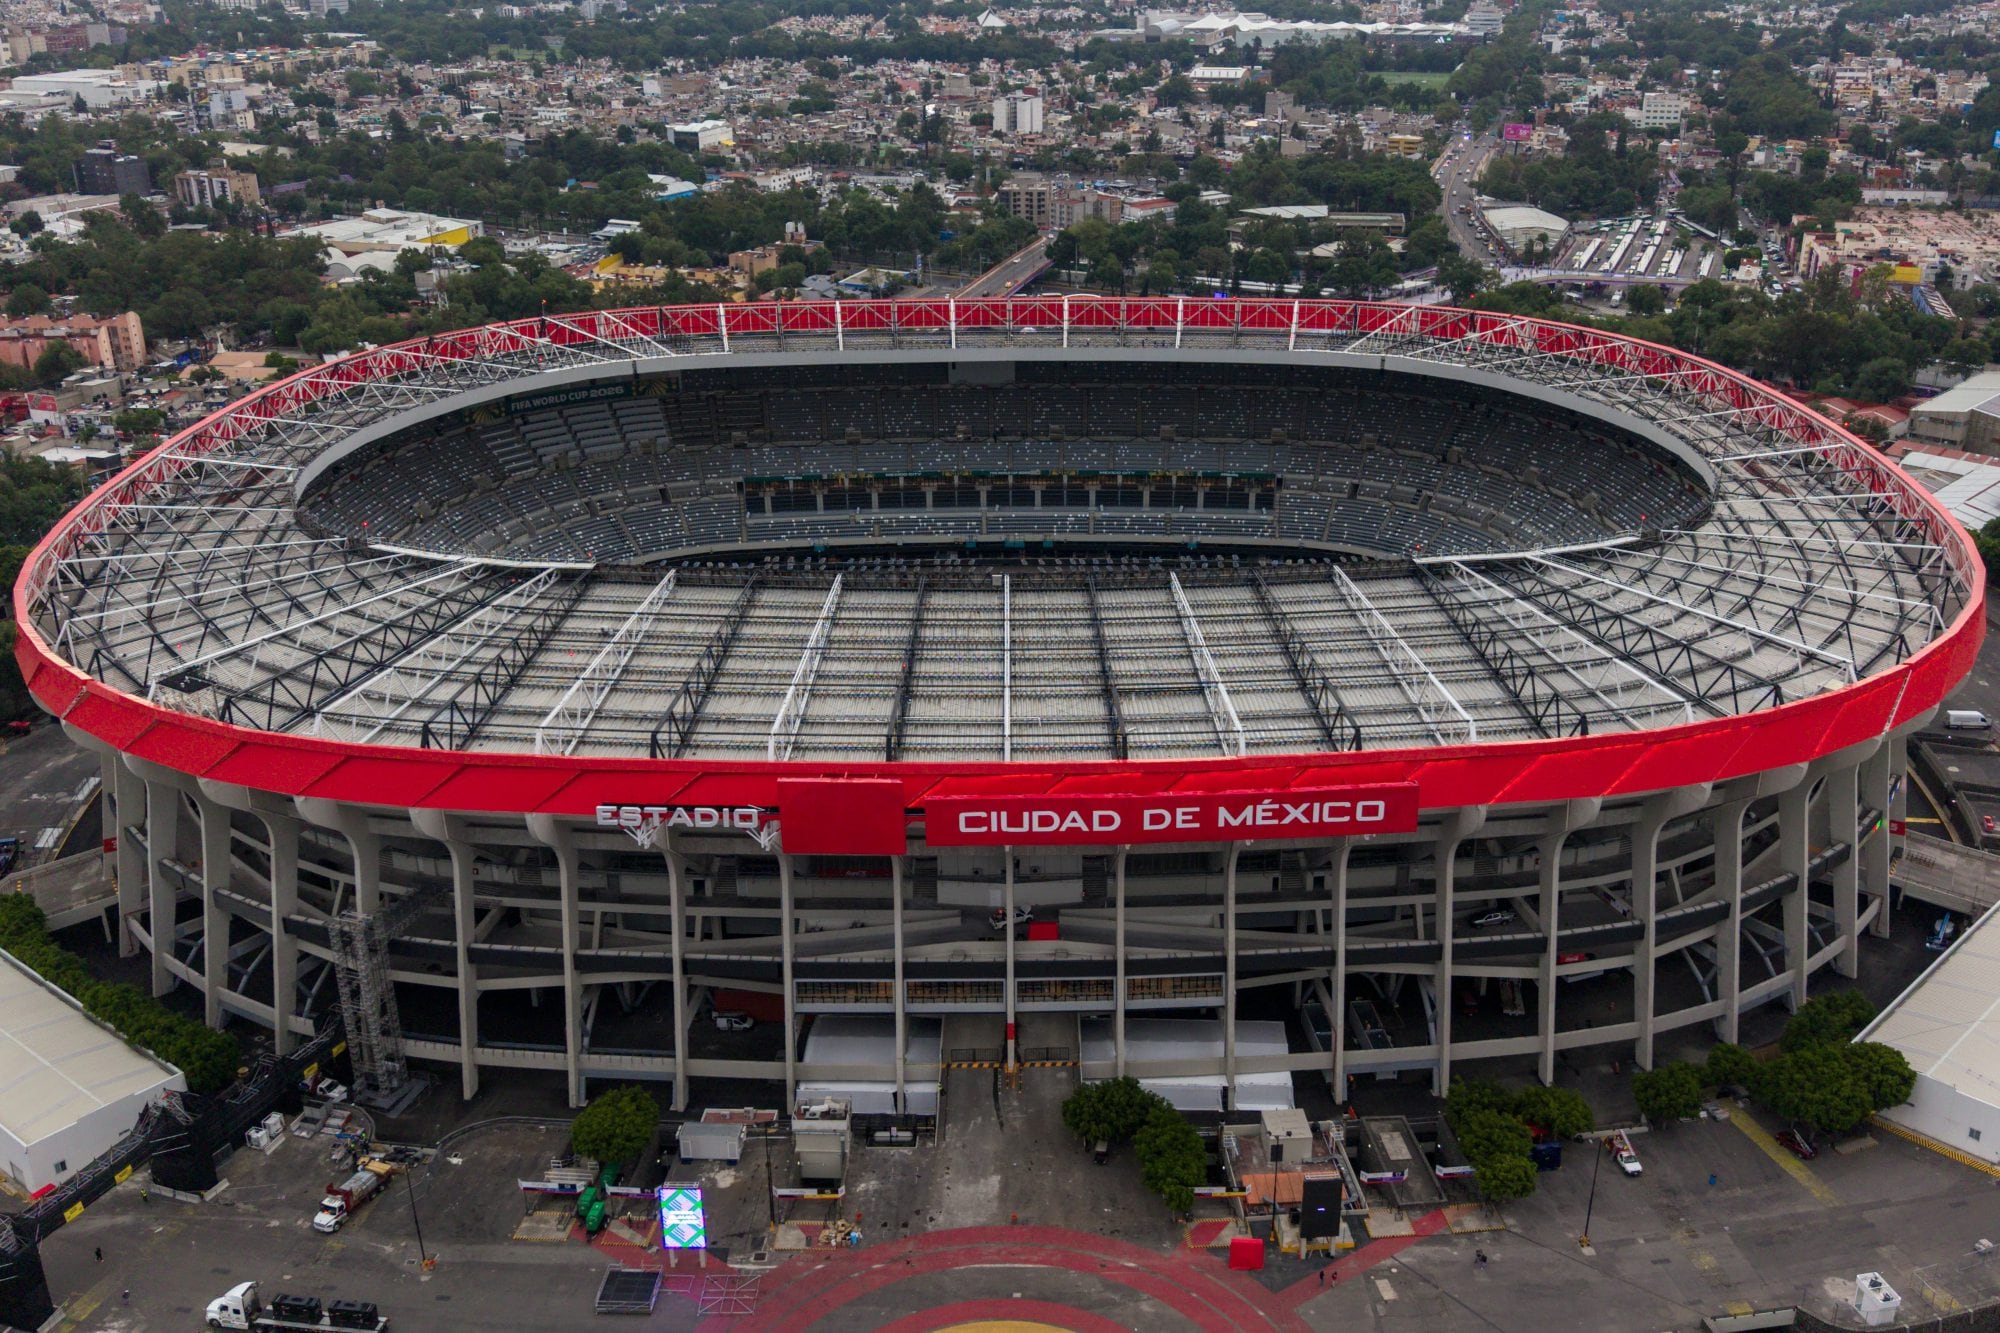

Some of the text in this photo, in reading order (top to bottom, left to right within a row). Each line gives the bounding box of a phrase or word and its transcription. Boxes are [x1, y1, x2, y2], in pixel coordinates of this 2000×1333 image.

[511, 386, 624, 411] FIFA WORLD CUP 2026
[596, 798, 1385, 833] ESTADIO CIUDAD DE MÉXICO
